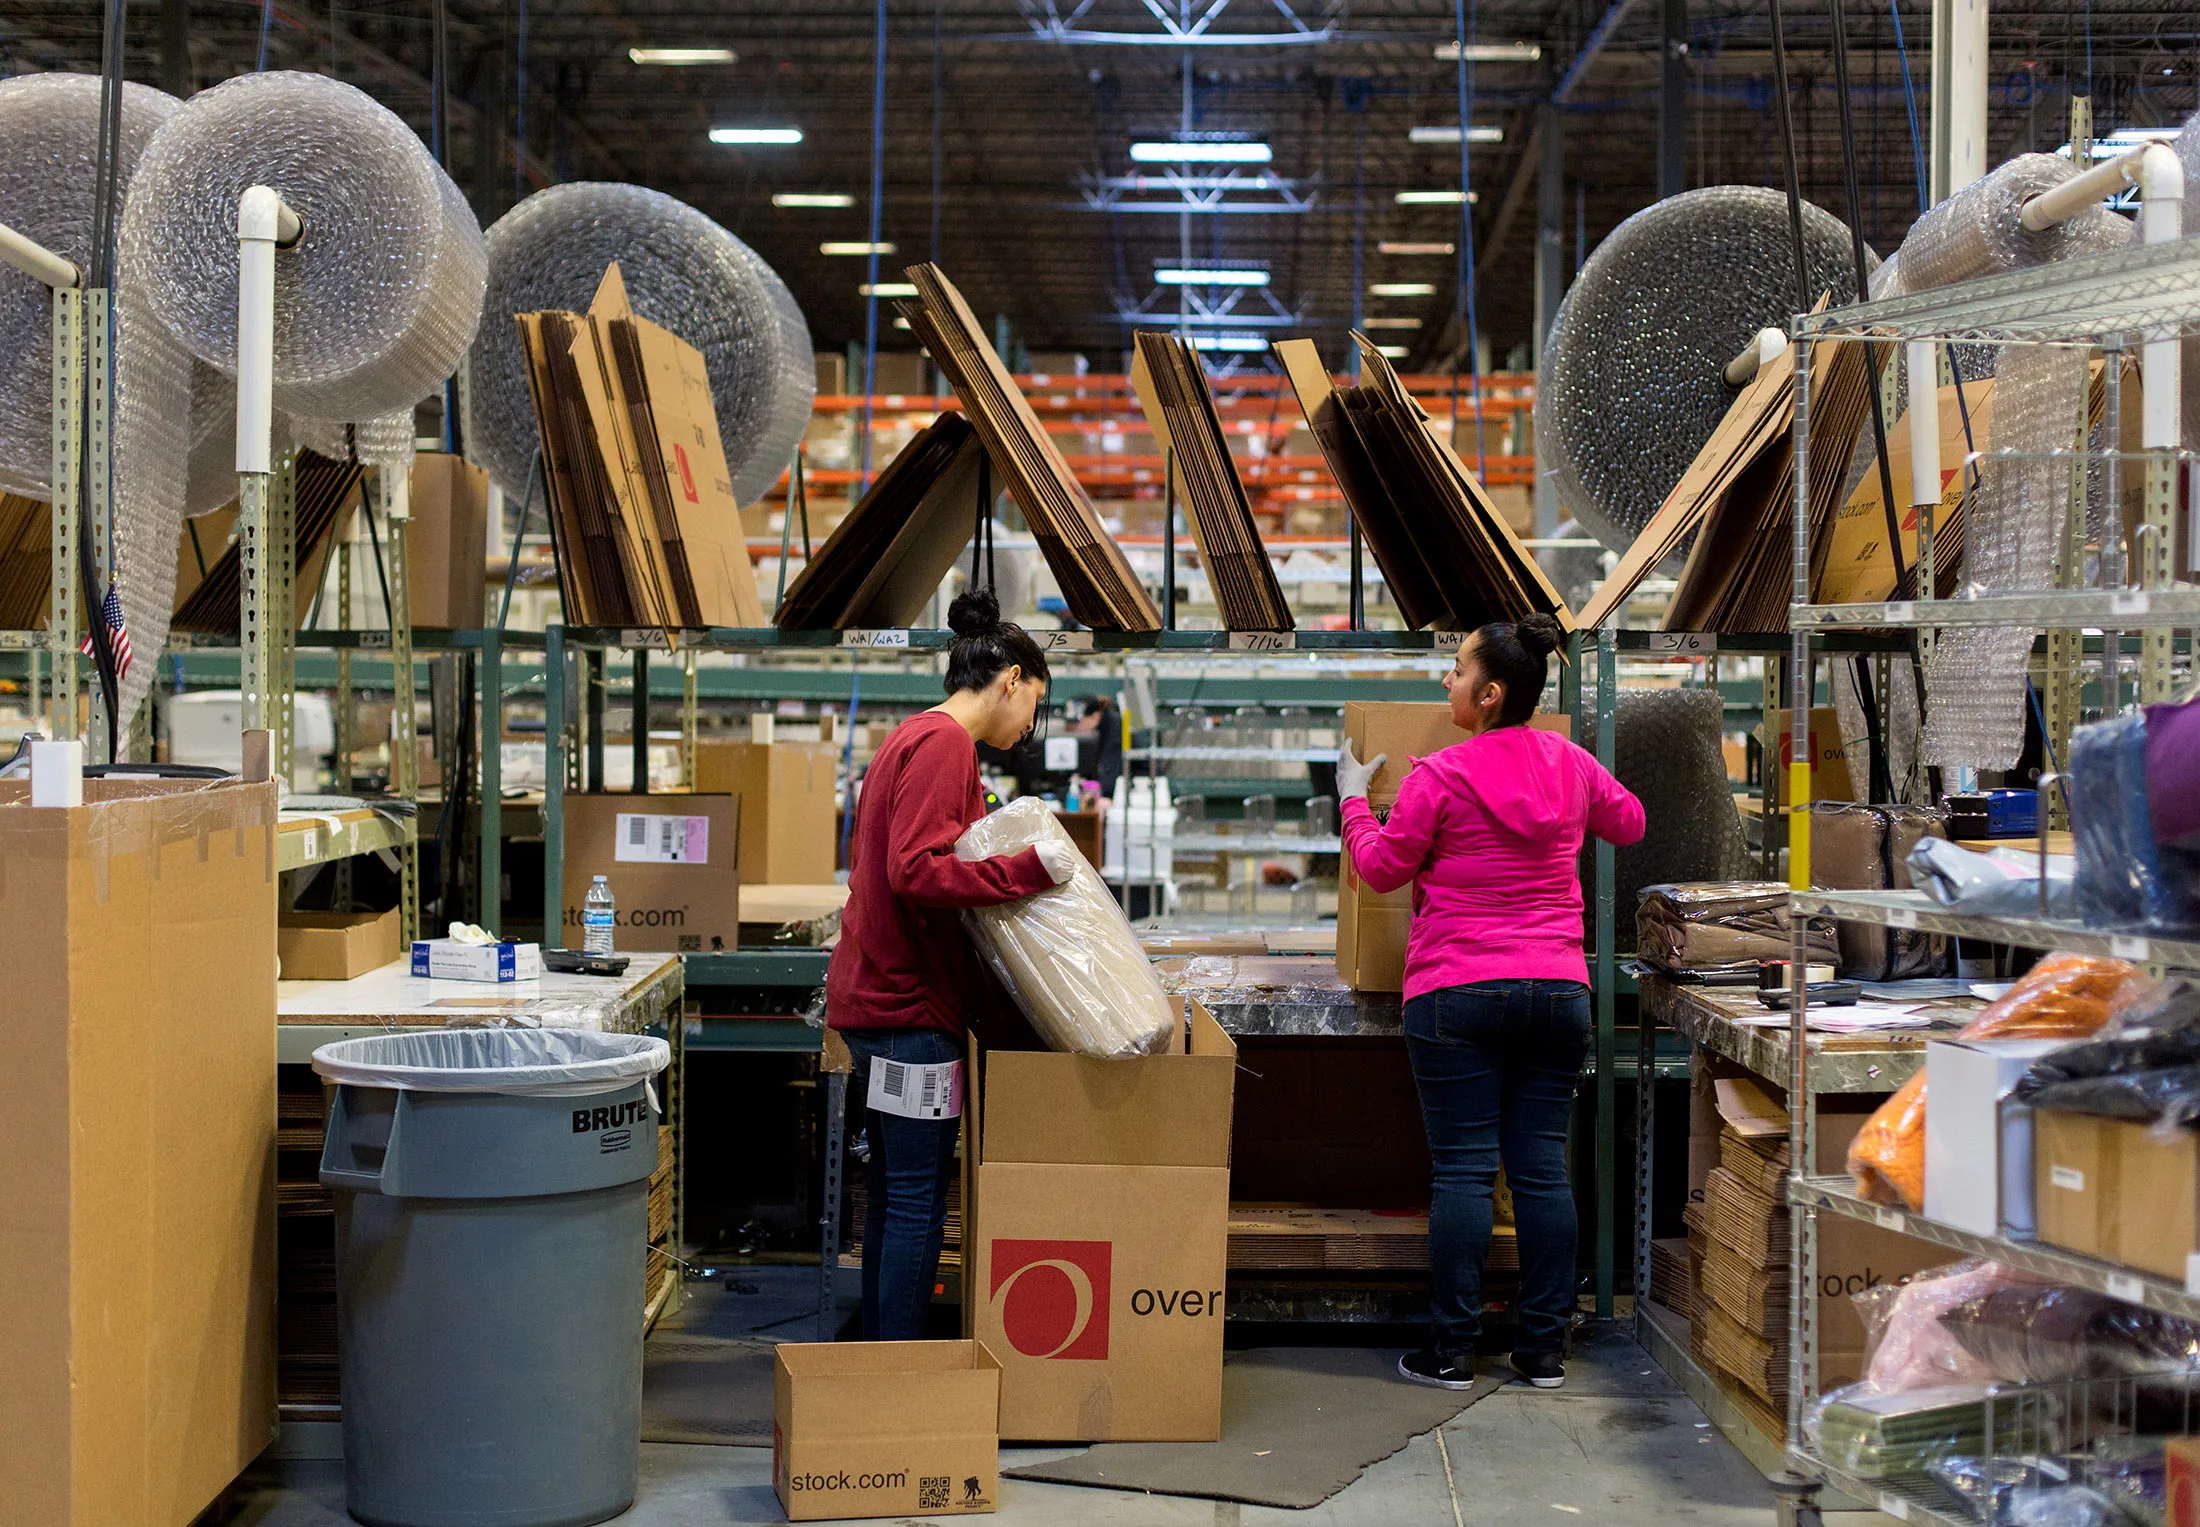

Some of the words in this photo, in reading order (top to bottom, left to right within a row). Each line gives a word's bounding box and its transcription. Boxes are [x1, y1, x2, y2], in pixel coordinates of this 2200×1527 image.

[635, 629, 663, 644] 3/6
[1246, 634, 1283, 650] 7/16
[1663, 633, 1700, 650] 3/6
[572, 1097, 649, 1133] BRUTE
[1131, 1288, 1223, 1317] over
